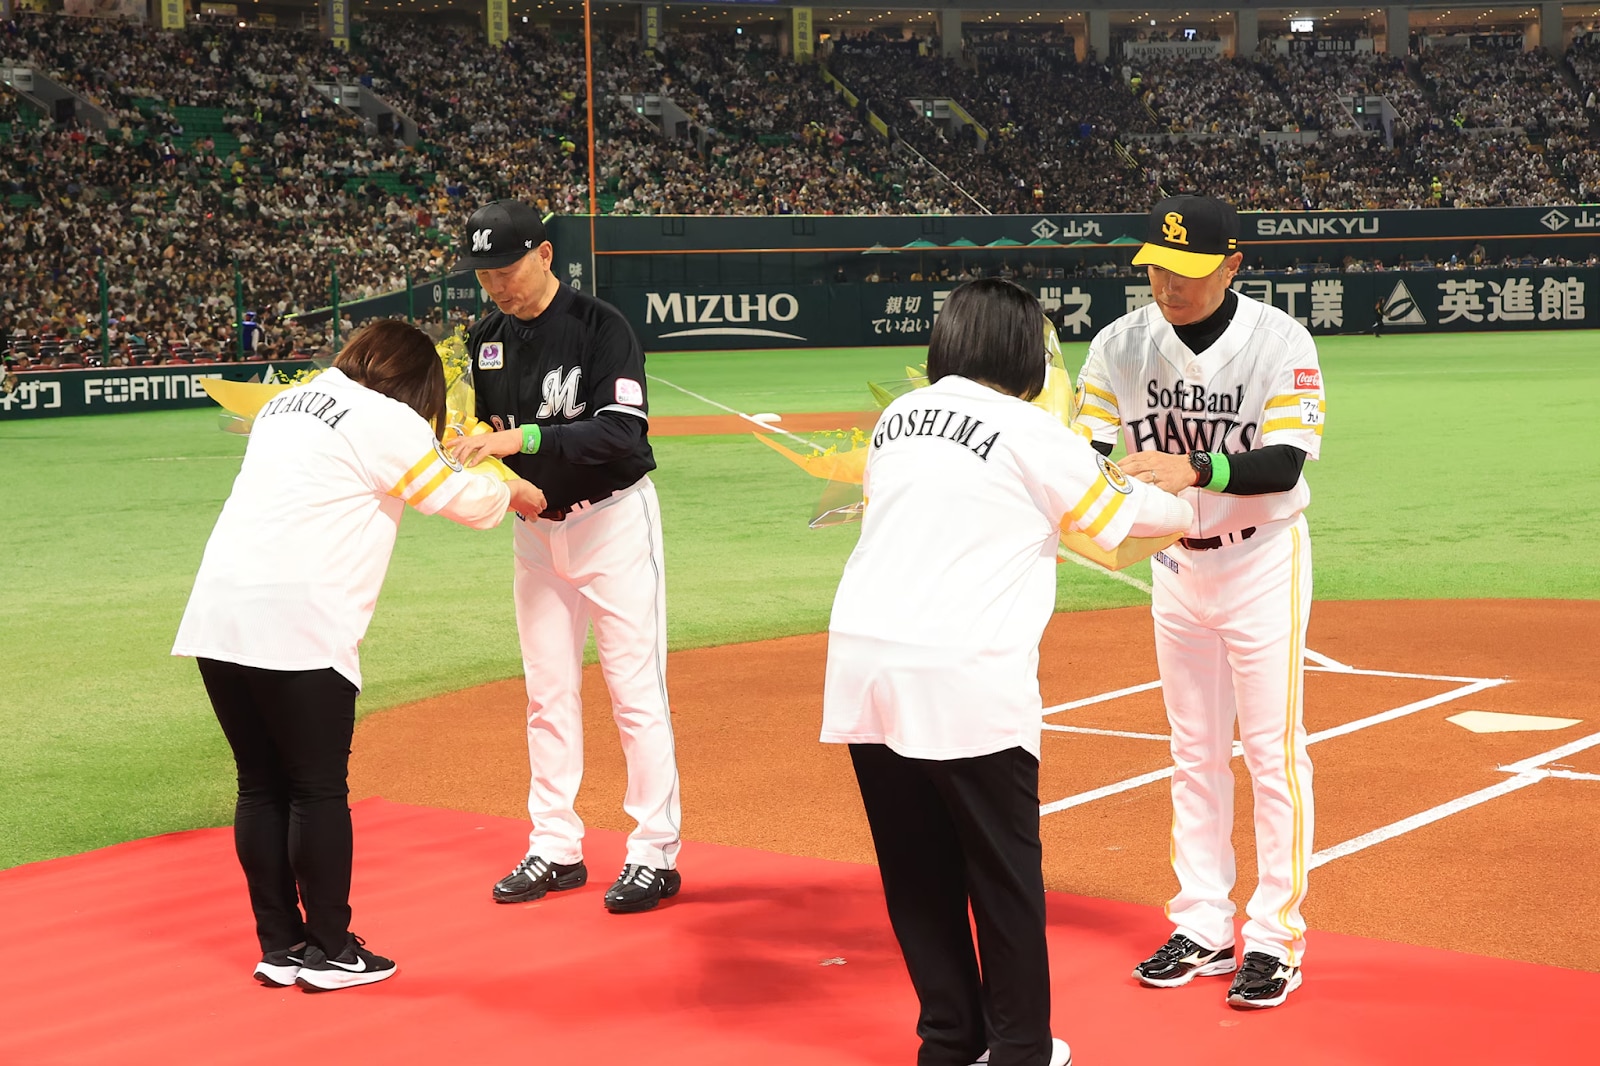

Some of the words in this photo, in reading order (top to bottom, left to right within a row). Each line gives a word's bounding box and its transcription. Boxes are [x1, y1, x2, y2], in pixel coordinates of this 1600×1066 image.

[1133, 46, 1173, 55] MARINES
[1063, 220, 1103, 237] 山九
[1257, 217, 1380, 235] SANKYU
[1574, 211, 1600, 228] 山
[471, 229, 493, 252] M
[645, 292, 799, 324] MIZUHO
[885, 296, 922, 314] 親切
[1437, 277, 1585, 324] 英進館
[871, 317, 930, 334] ていねい
[536, 365, 586, 419] M
[260, 391, 352, 430] ITAKURA
[873, 408, 1002, 462] GOSHIMA
[1127, 411, 1257, 455] HAWKS
